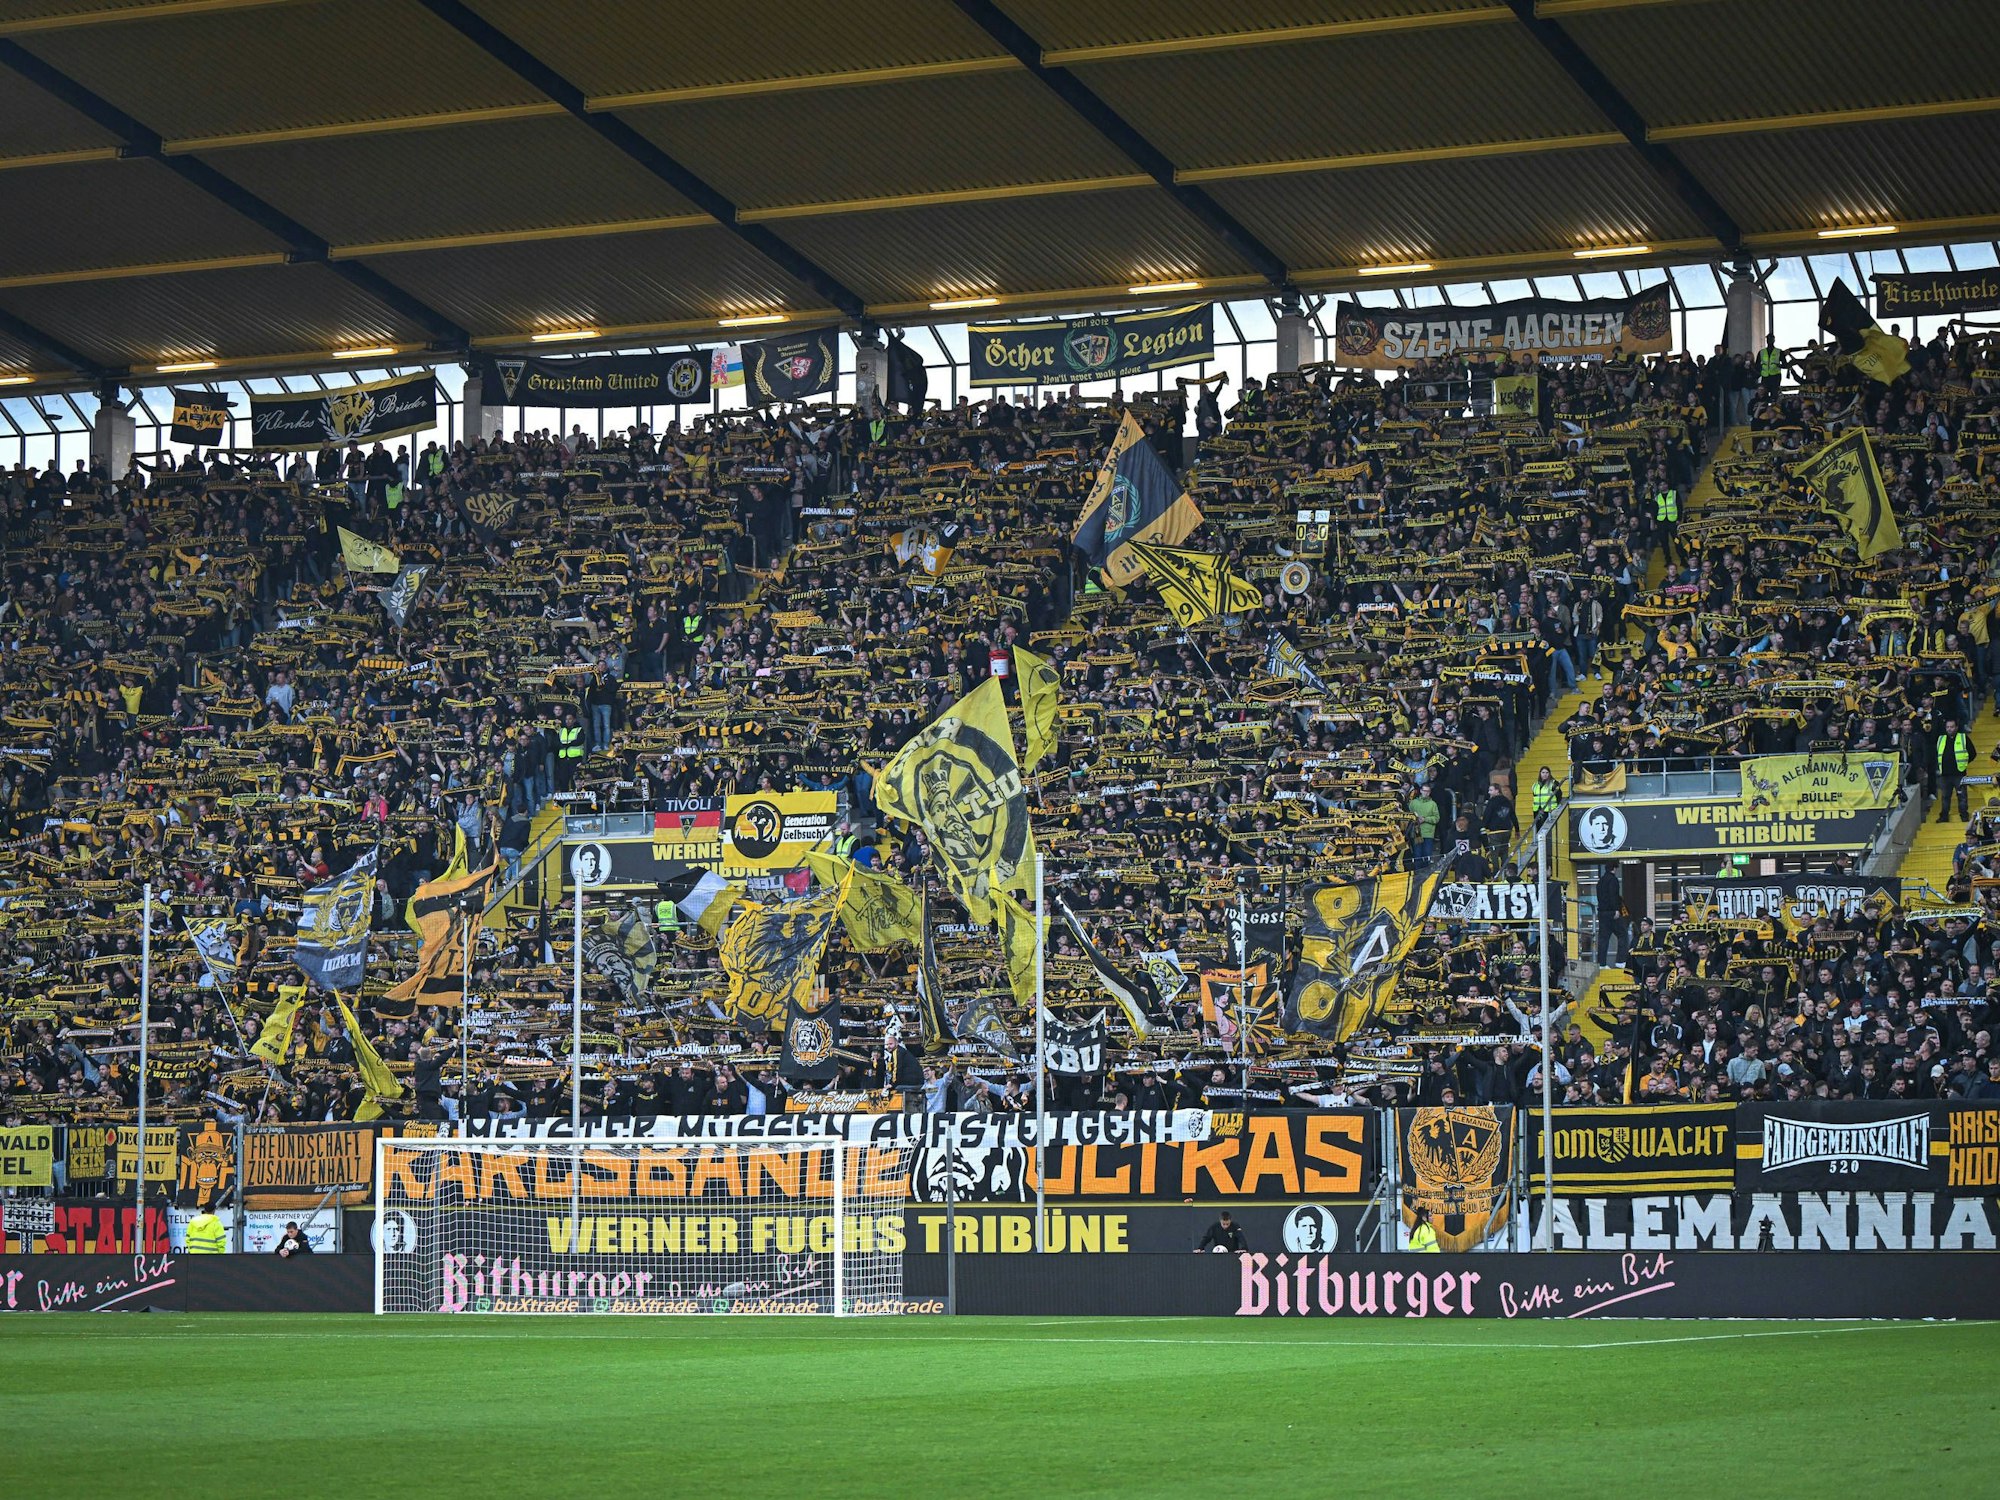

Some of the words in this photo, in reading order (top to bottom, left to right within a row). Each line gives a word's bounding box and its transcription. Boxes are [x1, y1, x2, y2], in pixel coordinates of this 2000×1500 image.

[1881, 279, 2000, 312] Eischwiele
[1090, 318, 1110, 328] 2012
[1383, 319, 1493, 359] SZENE
[1503, 312, 1625, 352] AACHEN
[985, 338, 1055, 371] Öcher
[1123, 322, 1204, 358] Legion
[527, 373, 604, 394] Grenzland
[607, 373, 659, 391] United
[1069, 372, 1093, 381] never
[1095, 367, 1117, 379] walk
[1119, 365, 1142, 376] alone
[376, 391, 427, 418] Brüder
[1575, 411, 1594, 419] WILL
[1545, 511, 1564, 519] WILL
[1782, 762, 1859, 785] ALEMANNIA'S
[1812, 778, 1829, 787] AU
[666, 800, 711, 811] TIVOLI
[784, 816, 827, 827] Generation
[783, 829, 826, 840] Gelbsucht
[1715, 823, 1816, 845] TRIBÜNE
[652, 843, 723, 861] WERNE
[1475, 884, 1541, 920] ATSV
[939, 924, 965, 932] FORZA
[1375, 1047, 1408, 1057] AACHEN
[792, 1091, 822, 1104] Keine
[824, 1089, 869, 1104] Sekunde
[1451, 1113, 1495, 1130] ALEMANNIA
[1948, 1110, 2000, 1144] KAIS
[68, 1127, 106, 1149] PYRO
[250, 1131, 361, 1160] FREUNDSCHAFT
[1461, 1128, 1478, 1149] A
[1631, 1125, 1729, 1158] WACHT
[1762, 1115, 1931, 1169] FAHRGEMEINSCHAFT
[0, 1156, 32, 1175] EL
[69, 1153, 106, 1170] KEIN
[383, 1128, 913, 1200] KARLSBANDE
[1024, 1114, 1366, 1196] ULTRAS
[1948, 1146, 2000, 1187] HOO
[247, 1156, 362, 1187] ZUSAMMENHALT
[1458, 1202, 1478, 1214] 1900
[1532, 1191, 1997, 1252] ALEMANNIA
[546, 1216, 738, 1254] WERNER
[751, 1216, 908, 1254] FUCHS
[917, 1213, 1129, 1254] TRIBÜNE
[37, 1280, 87, 1312] Bitte
[96, 1275, 128, 1294] ein
[134, 1253, 175, 1282] Bit
[1235, 1252, 1482, 1318] Bitburger
[1499, 1282, 1564, 1318] Bitte
[1573, 1277, 1615, 1299] ein
[1620, 1252, 1675, 1286] Bit
[493, 1298, 580, 1314] buXtrade
[611, 1298, 698, 1314] buXtrade
[730, 1299, 820, 1315] buXtrade
[853, 1299, 945, 1316] buXtrade
